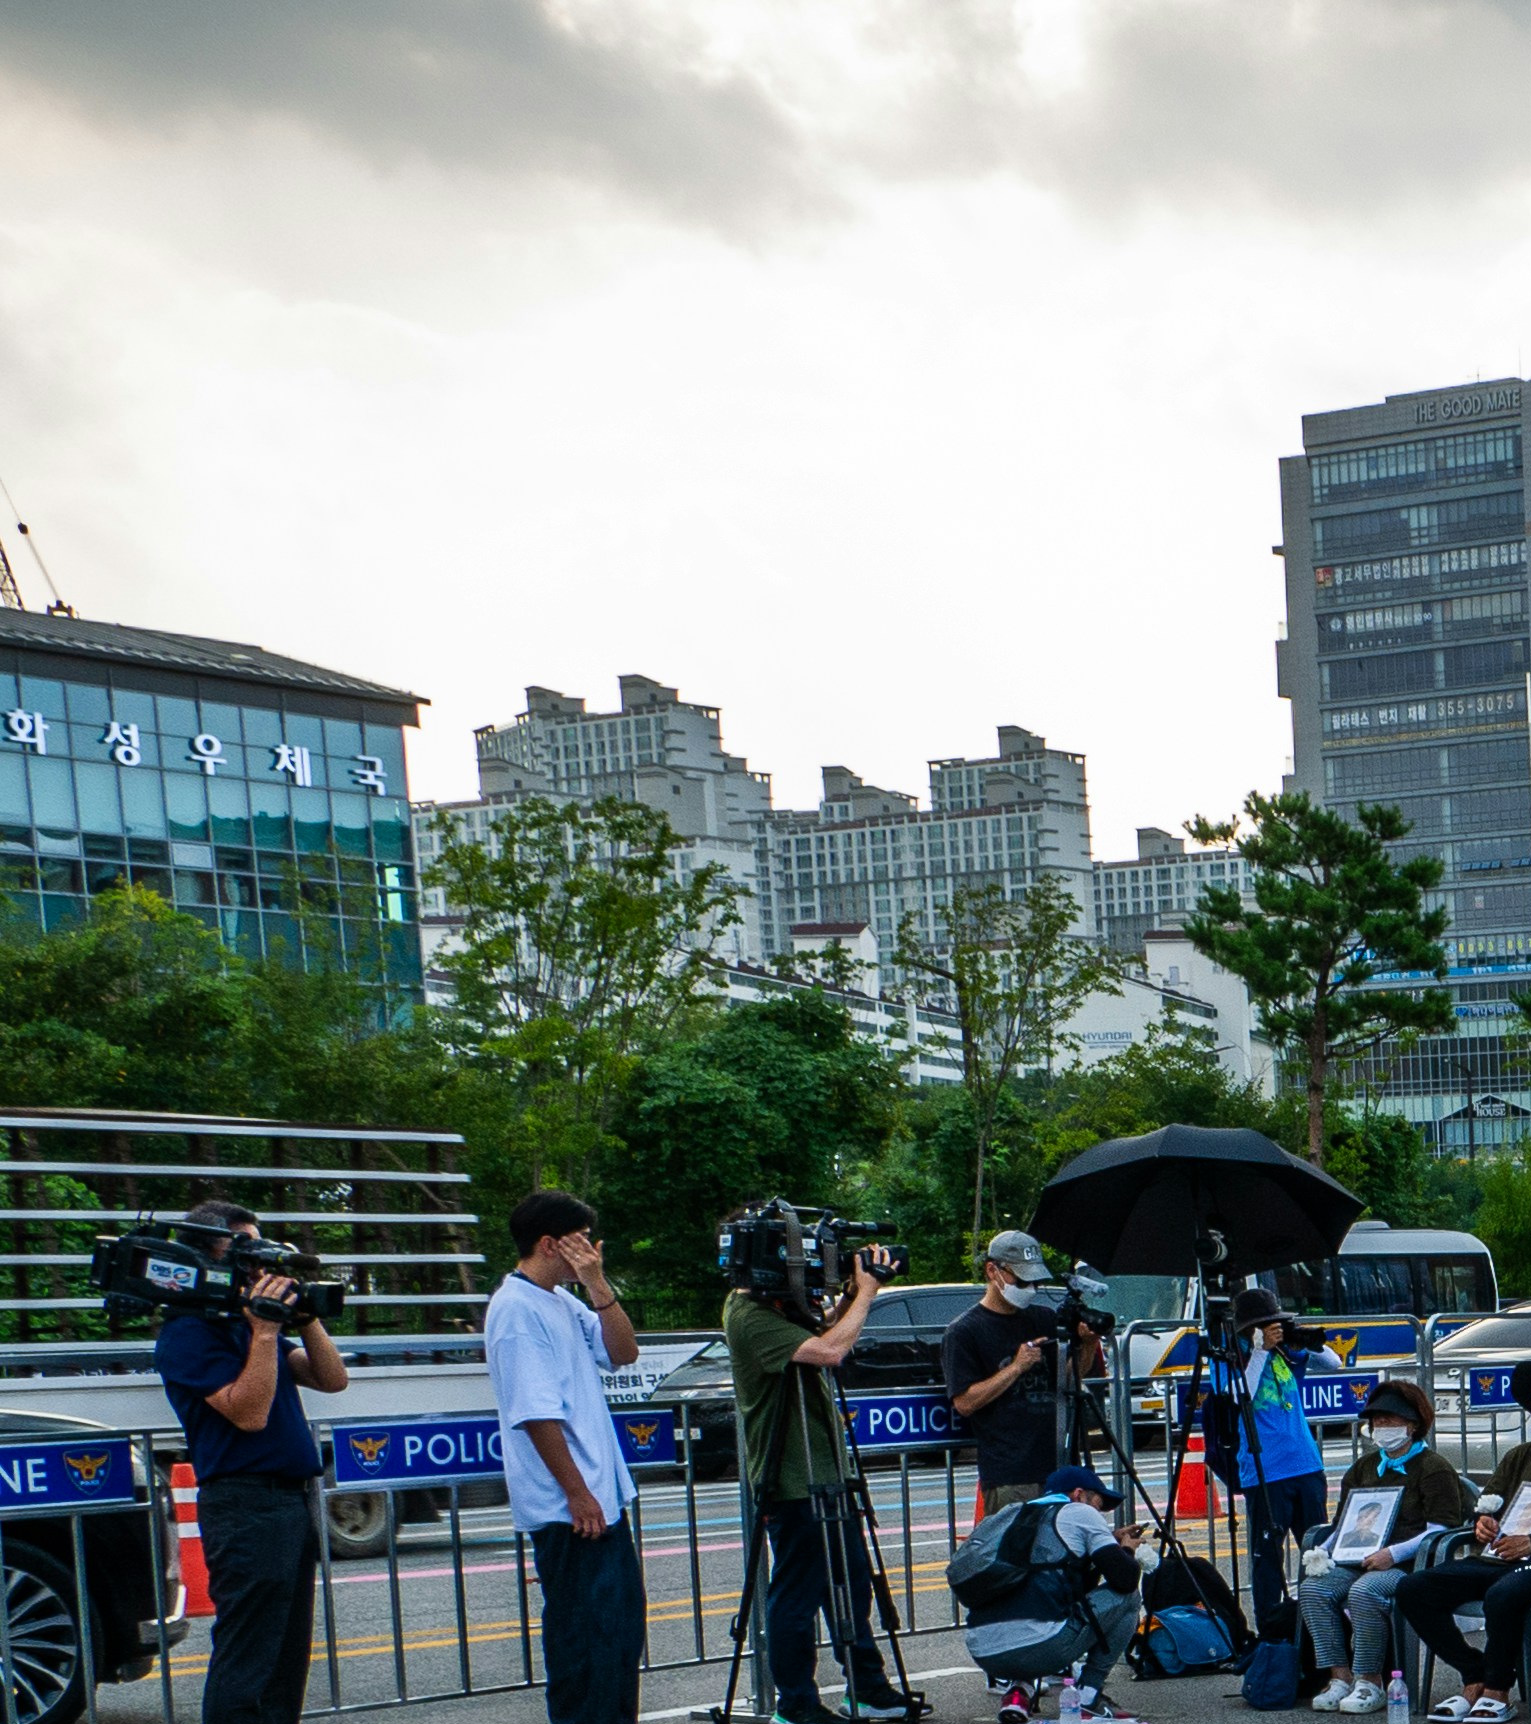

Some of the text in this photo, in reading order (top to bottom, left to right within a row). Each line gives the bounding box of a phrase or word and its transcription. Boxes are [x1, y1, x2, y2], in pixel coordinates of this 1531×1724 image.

[1414, 389, 1522, 424] THE GOOD MATE
[6, 708, 388, 797] 화성우체국
[1303, 1379, 1344, 1410] LINE
[870, 1405, 963, 1435] POLICE
